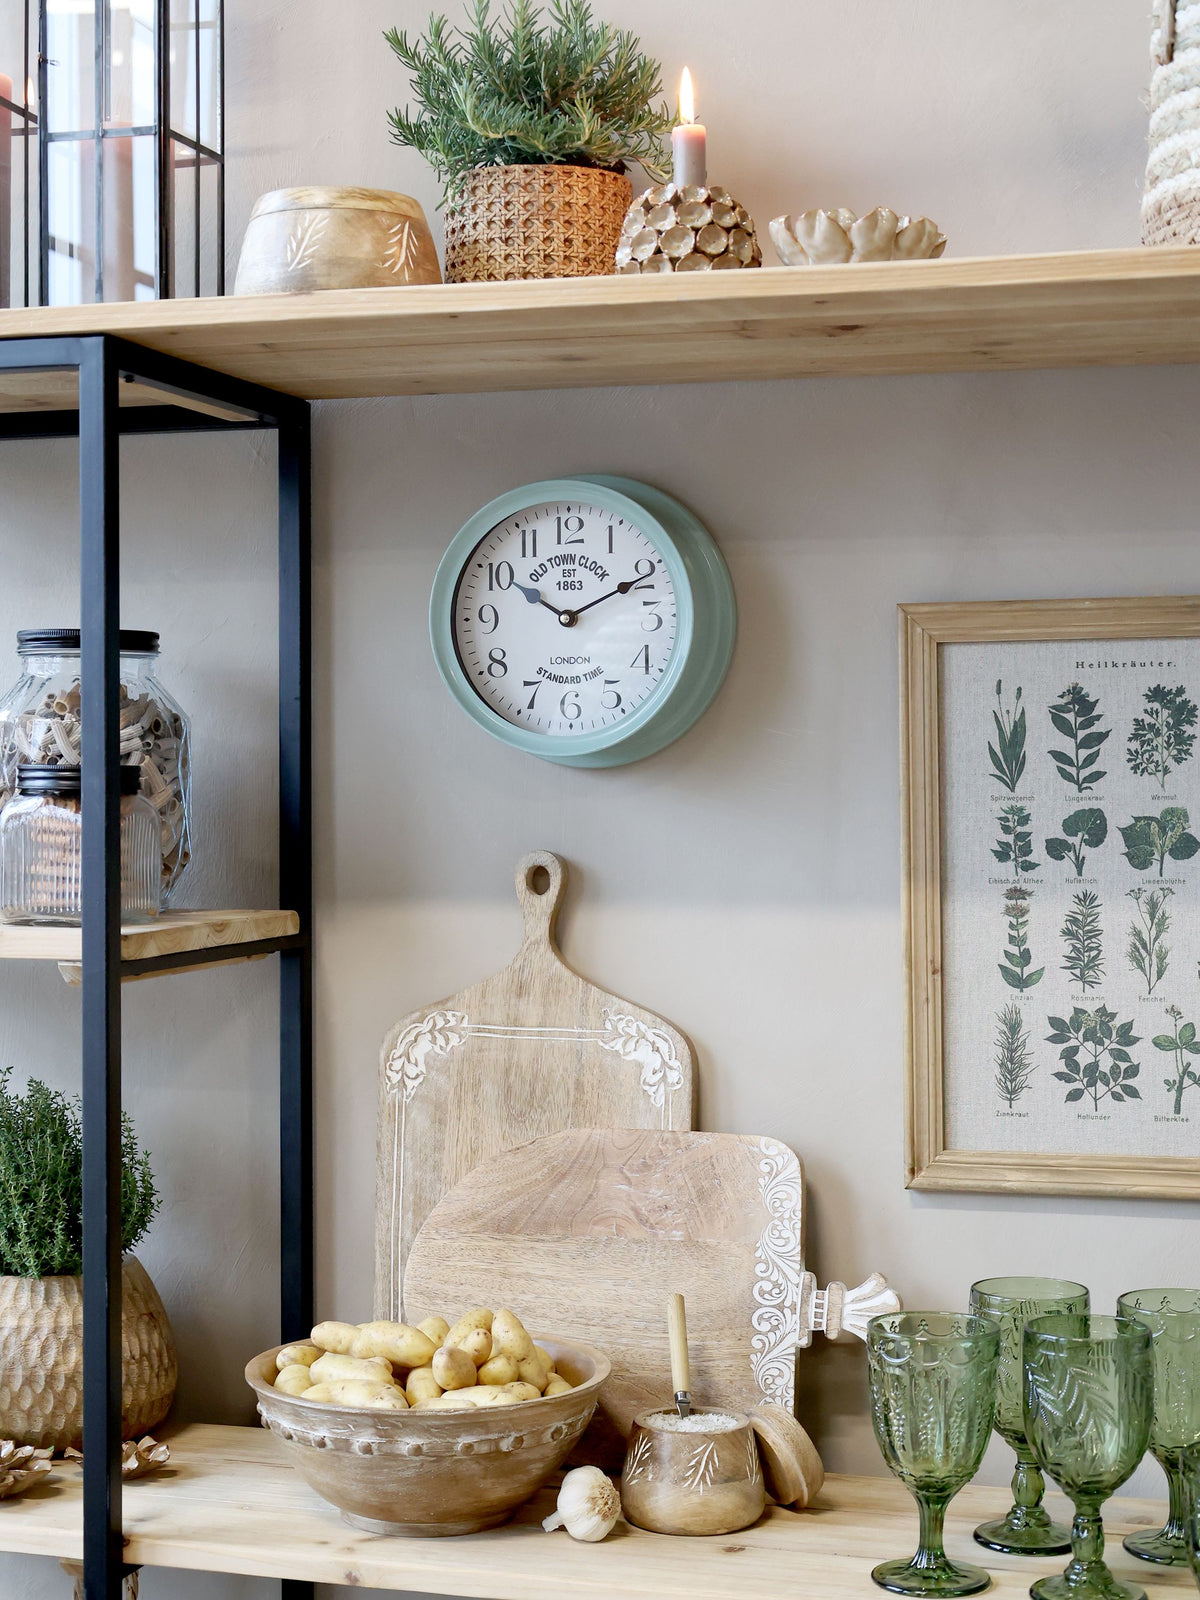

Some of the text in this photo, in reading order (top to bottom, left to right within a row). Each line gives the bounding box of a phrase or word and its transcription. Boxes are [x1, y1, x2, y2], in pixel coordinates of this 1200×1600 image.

[520, 529, 537, 558] 11
[554, 515, 585, 545] 12
[606, 525, 615, 554] 1
[486, 560, 515, 591] 10
[529, 553, 610, 583] OLD TOWN CLOCK
[562, 569, 577, 578] EST
[634, 558, 656, 590] 2
[556, 580, 583, 591] 1863
[478, 604, 500, 634] 9
[640, 601, 663, 632] 3
[487, 647, 508, 678] 8
[549, 656, 591, 665] LONDON
[630, 644, 654, 675] 4
[1075, 660, 1177, 669] Heilkräuter.
[536, 665, 605, 685] STANDARD TIME
[523, 680, 543, 710] 7
[559, 690, 582, 720] 6
[600, 679, 623, 709] 5
